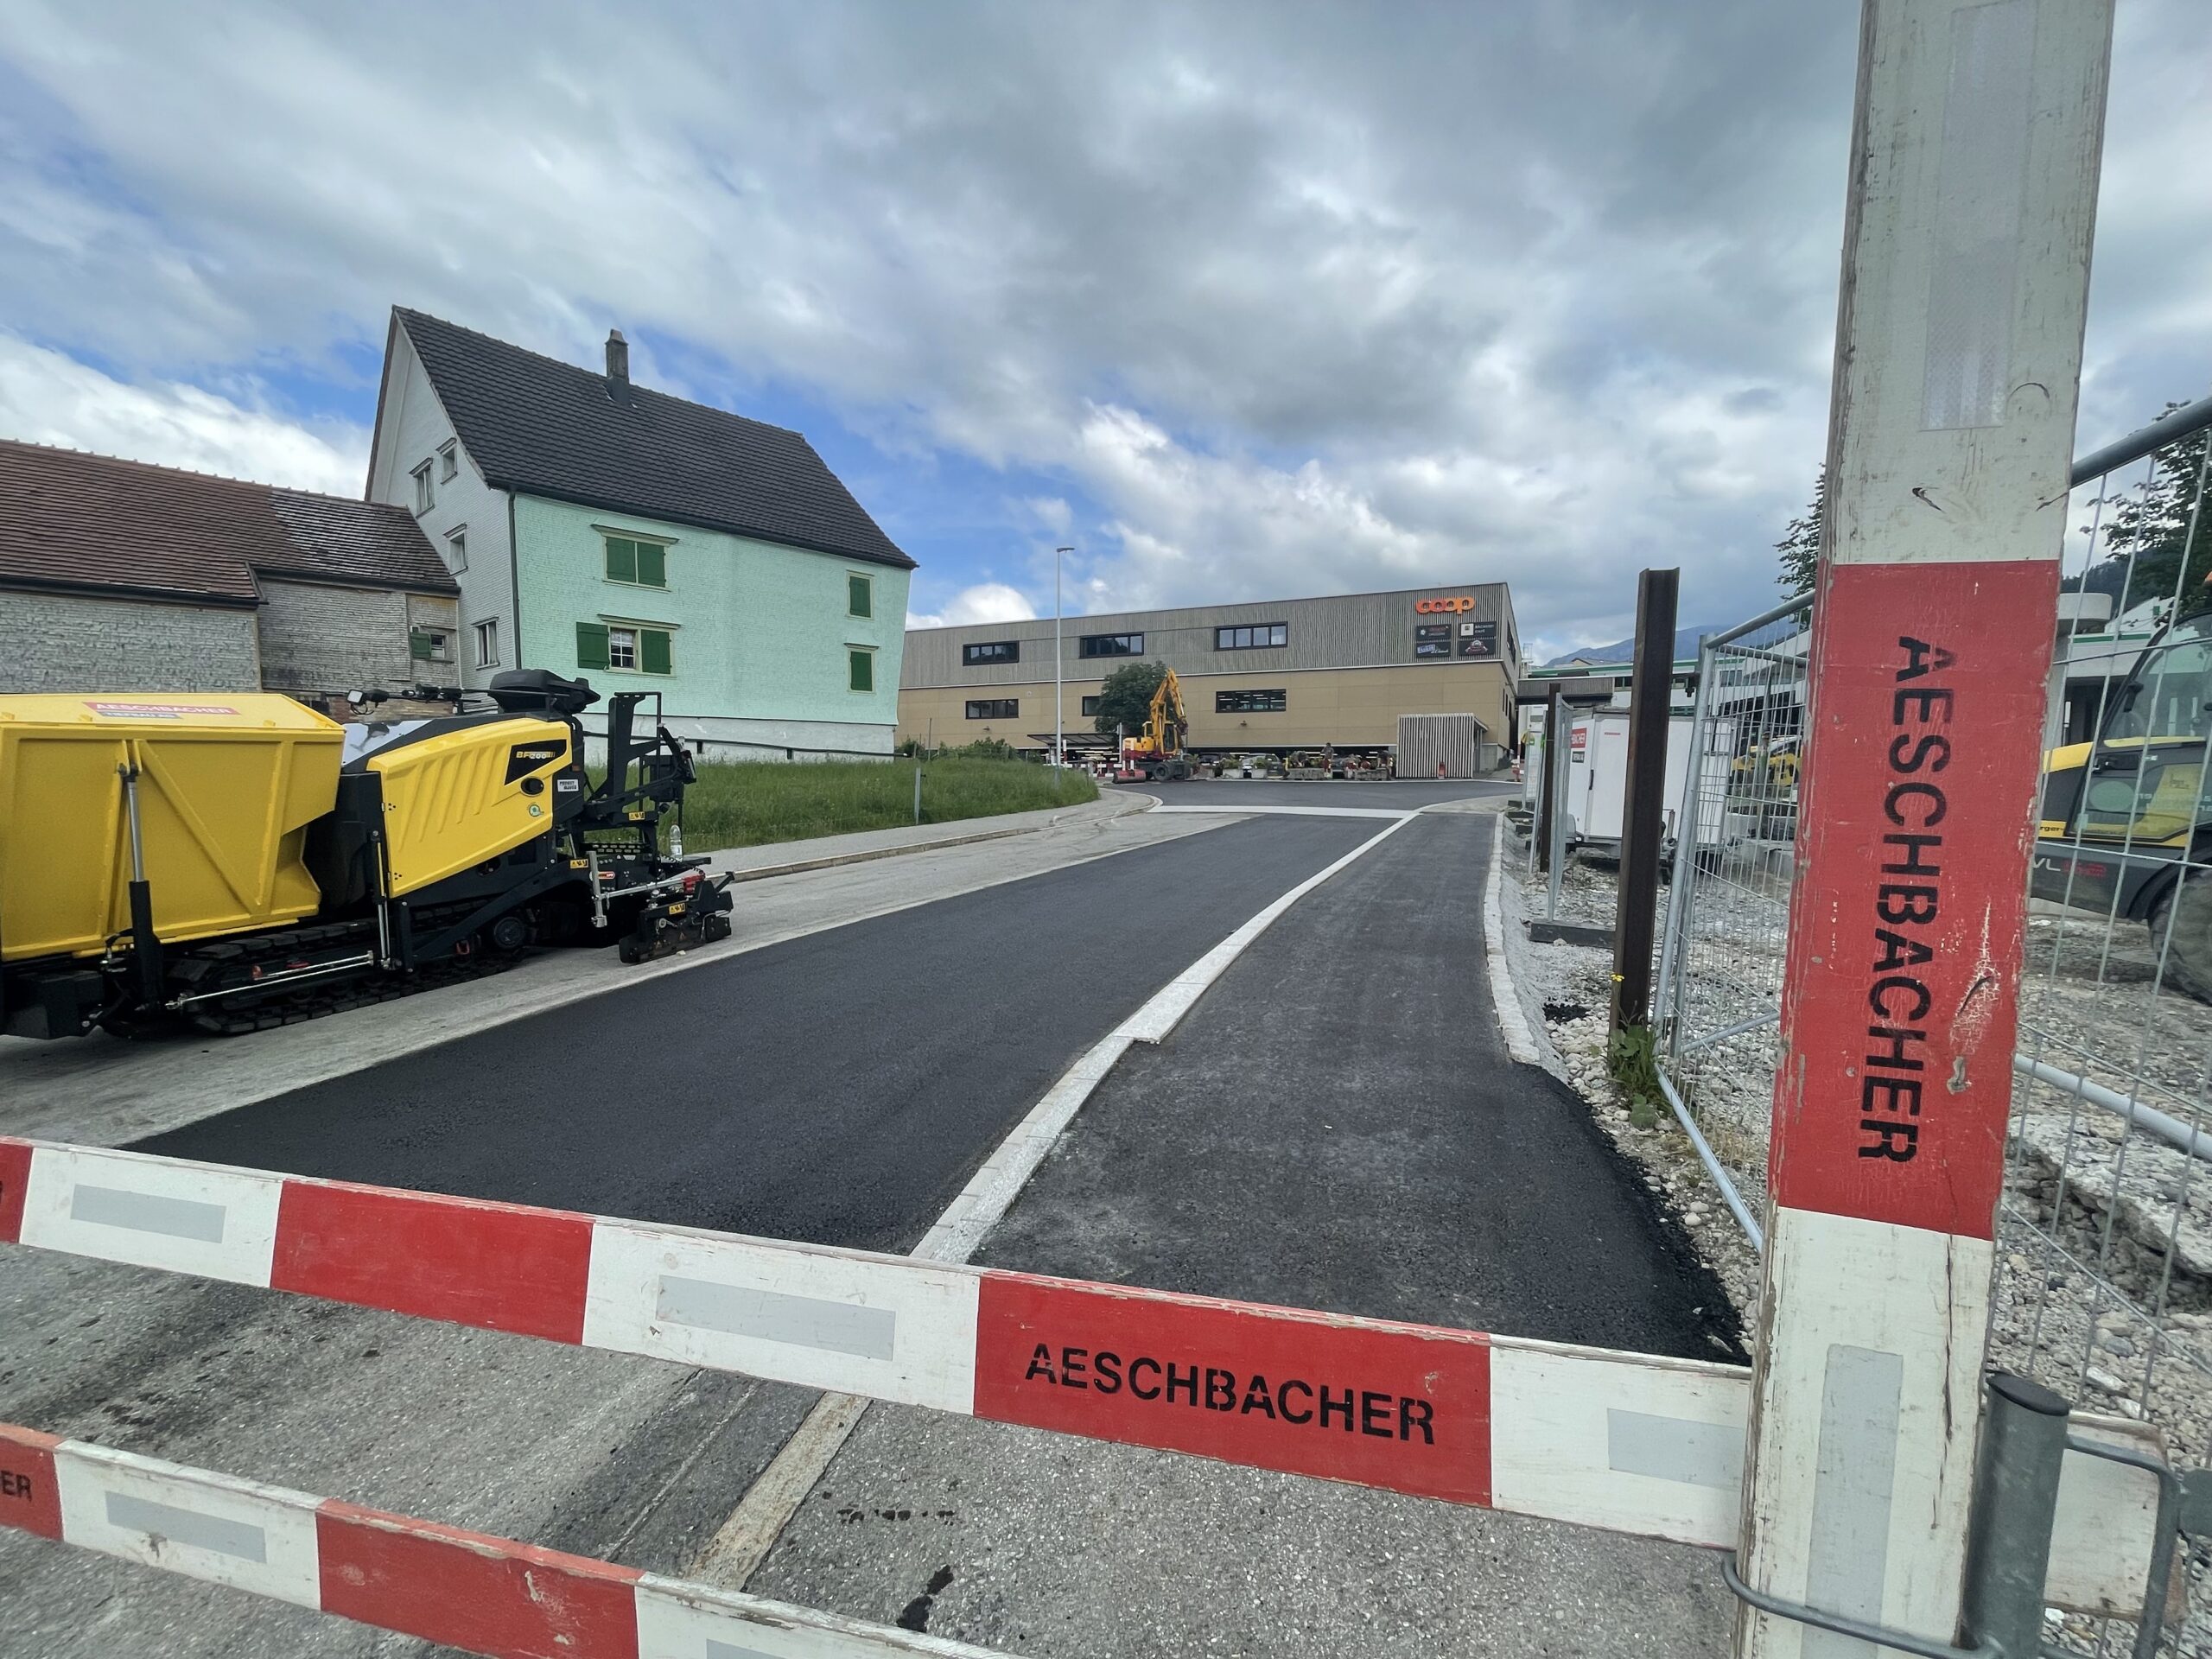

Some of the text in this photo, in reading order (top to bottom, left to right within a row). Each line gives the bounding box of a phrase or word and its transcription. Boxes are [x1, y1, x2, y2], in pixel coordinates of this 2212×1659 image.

[1416, 597, 1475, 615] coop
[96, 703, 232, 714] AESCHBACHER
[1858, 635, 1957, 1164] AESCHBACHER
[1026, 1343, 1435, 1445] AESCHBACHER
